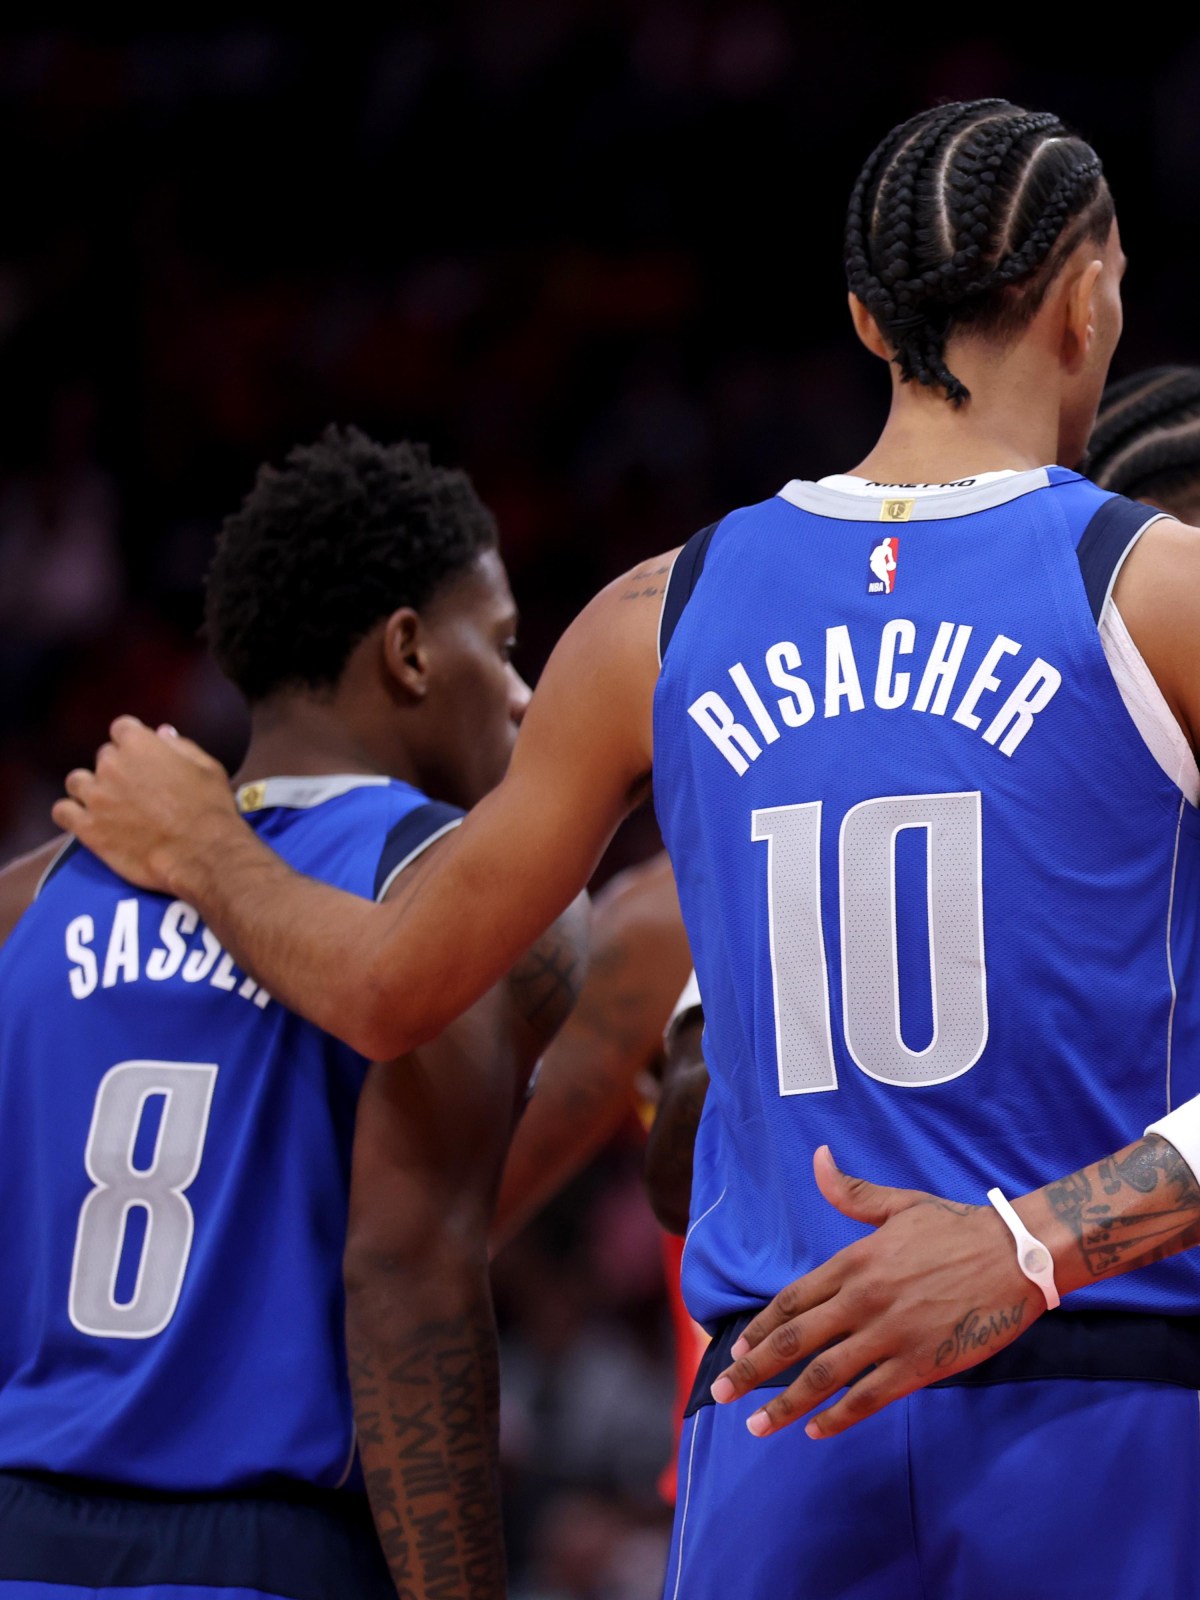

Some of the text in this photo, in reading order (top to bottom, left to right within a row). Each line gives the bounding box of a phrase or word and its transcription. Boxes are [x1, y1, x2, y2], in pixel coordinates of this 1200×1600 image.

[868, 582, 884, 593] NBA
[688, 618, 1062, 777] RISACHER
[65, 898, 272, 1010] SASS
[751, 790, 989, 1097] 10
[68, 1059, 219, 1340] 8
